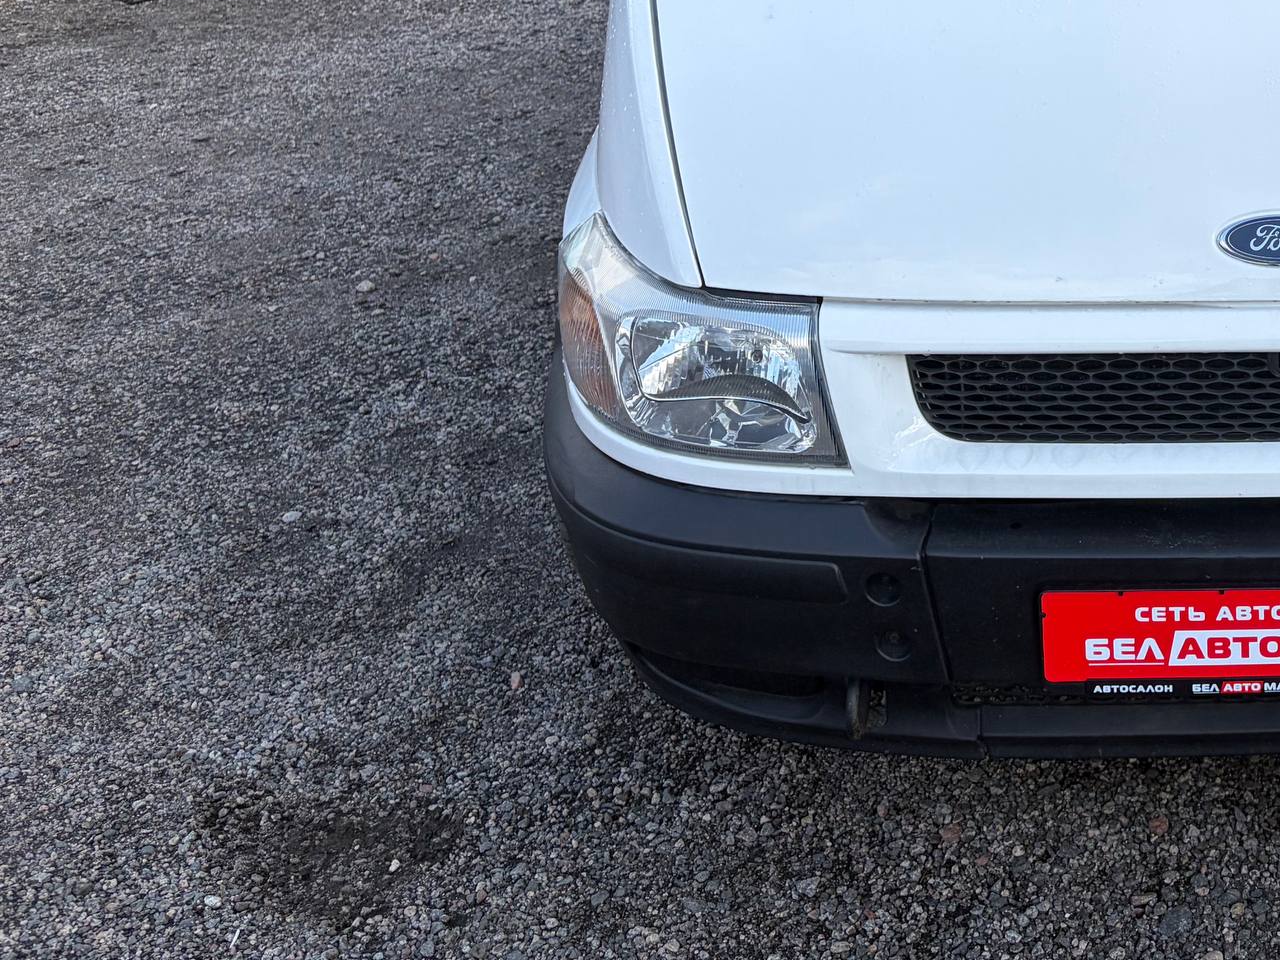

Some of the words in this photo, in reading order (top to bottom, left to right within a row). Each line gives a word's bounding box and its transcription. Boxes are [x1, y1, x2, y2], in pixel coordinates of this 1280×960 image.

[1134, 606, 1206, 622] СЕТЬ
[1084, 637, 1165, 661] БЕЛ
[1093, 684, 1174, 694] АВТОСАЛОН
[1191, 683, 1220, 693] БЕЛ
[1223, 682, 1262, 692] АВТО
